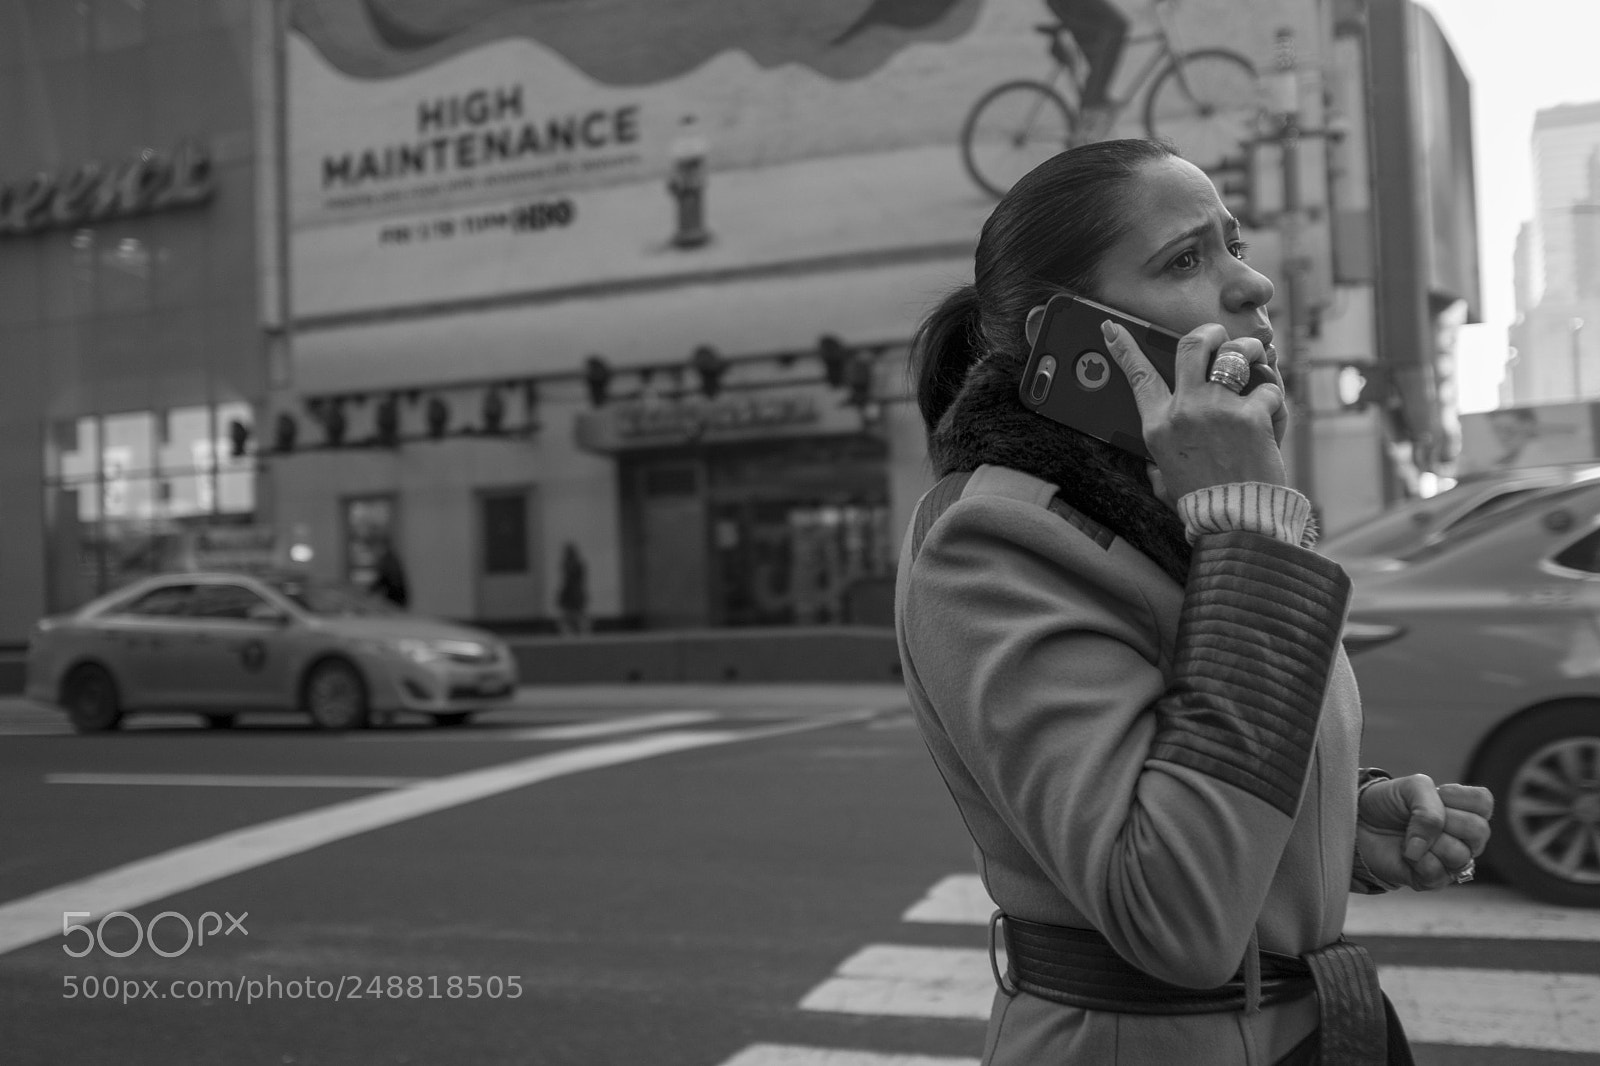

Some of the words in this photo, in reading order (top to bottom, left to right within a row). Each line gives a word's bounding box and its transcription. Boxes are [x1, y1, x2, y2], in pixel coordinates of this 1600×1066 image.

[418, 84, 524, 133] HIGH
[322, 106, 641, 189] MAINTENANCE
[511, 199, 576, 235] HBO
